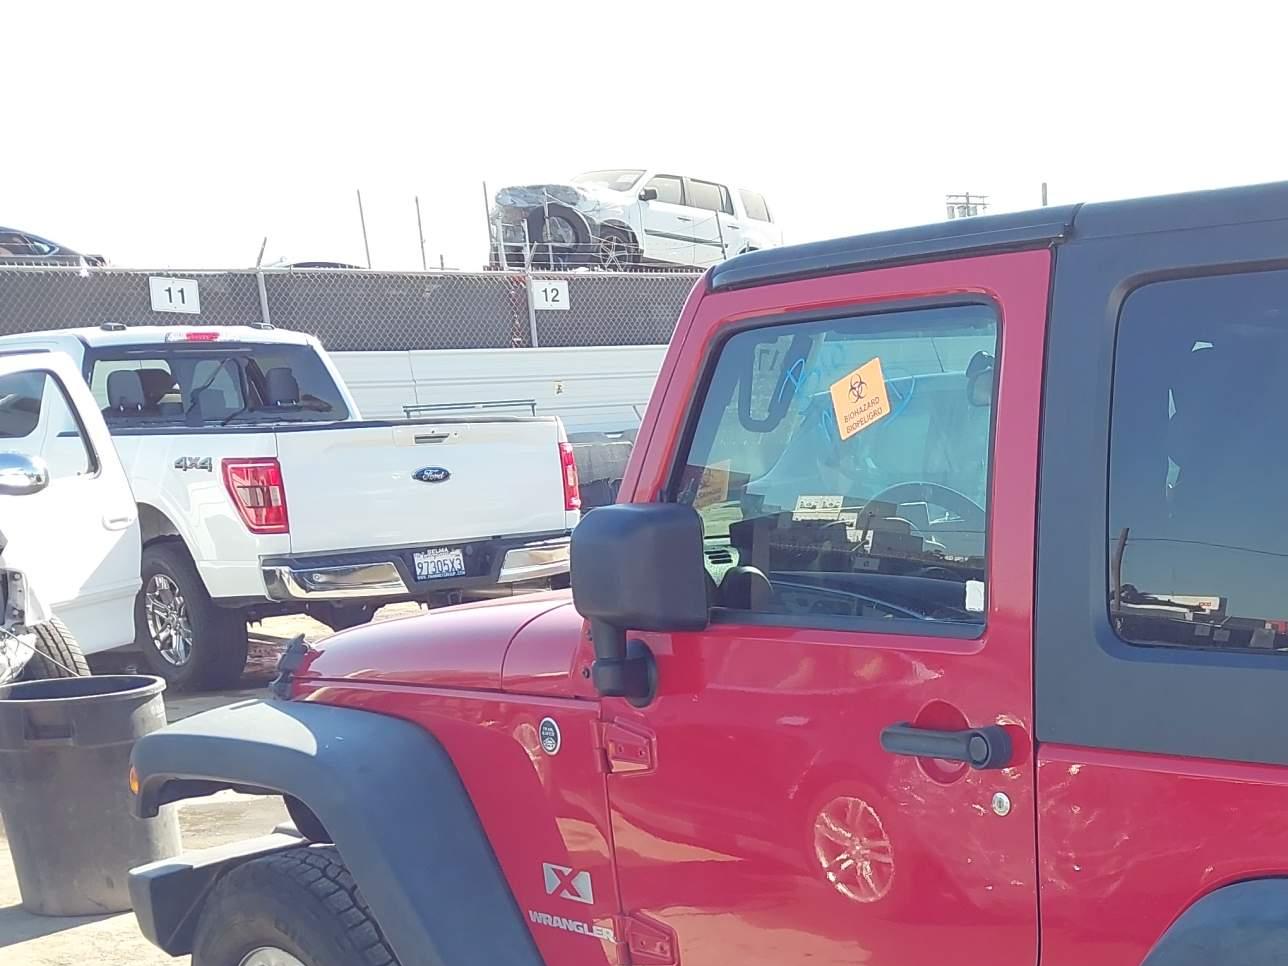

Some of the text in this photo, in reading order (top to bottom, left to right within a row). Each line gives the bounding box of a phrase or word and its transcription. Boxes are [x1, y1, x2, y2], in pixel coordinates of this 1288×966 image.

[164, 286, 185, 305] 11
[541, 287, 560, 303] 12
[844, 396, 880, 424] BIOHAZARD
[846, 407, 883, 434] BIOPELIGRO
[528, 910, 617, 944] WRANGLER
